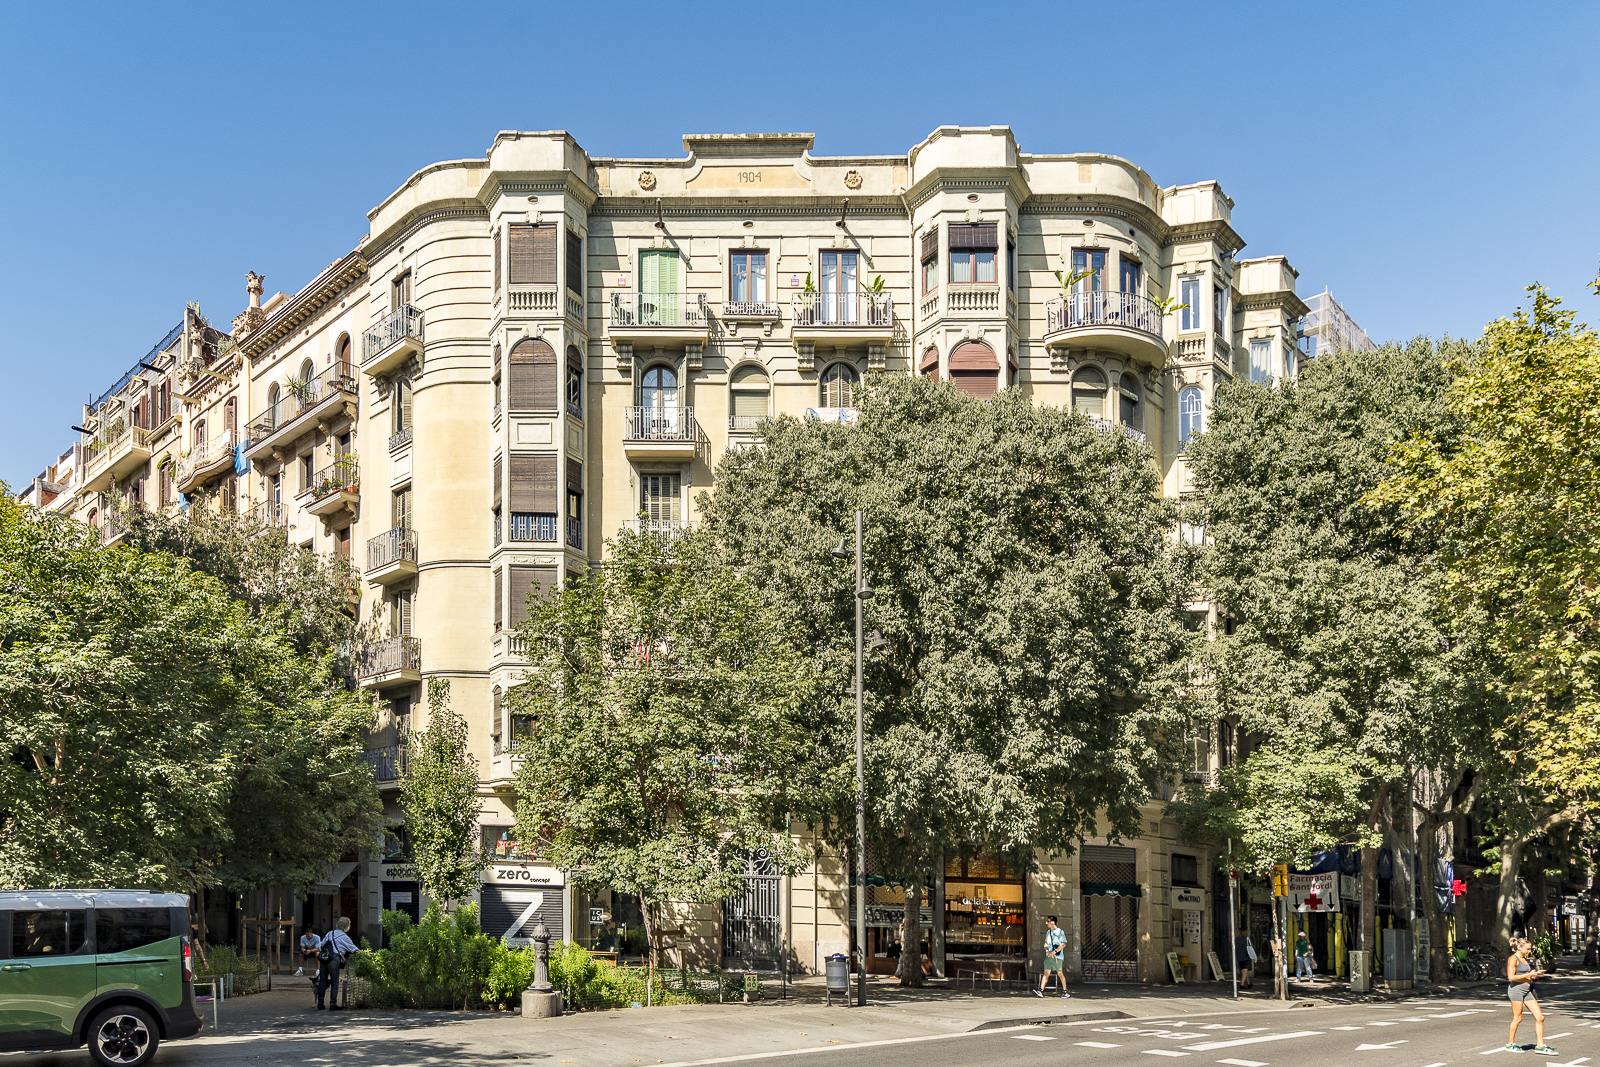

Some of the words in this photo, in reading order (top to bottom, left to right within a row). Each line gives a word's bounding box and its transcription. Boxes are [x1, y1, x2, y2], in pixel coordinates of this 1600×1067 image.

[737, 171, 762, 183] 1904
[497, 870, 530, 880] zero
[1290, 874, 1333, 882] Farmacia
[1091, 1026, 1211, 1039] BUS
